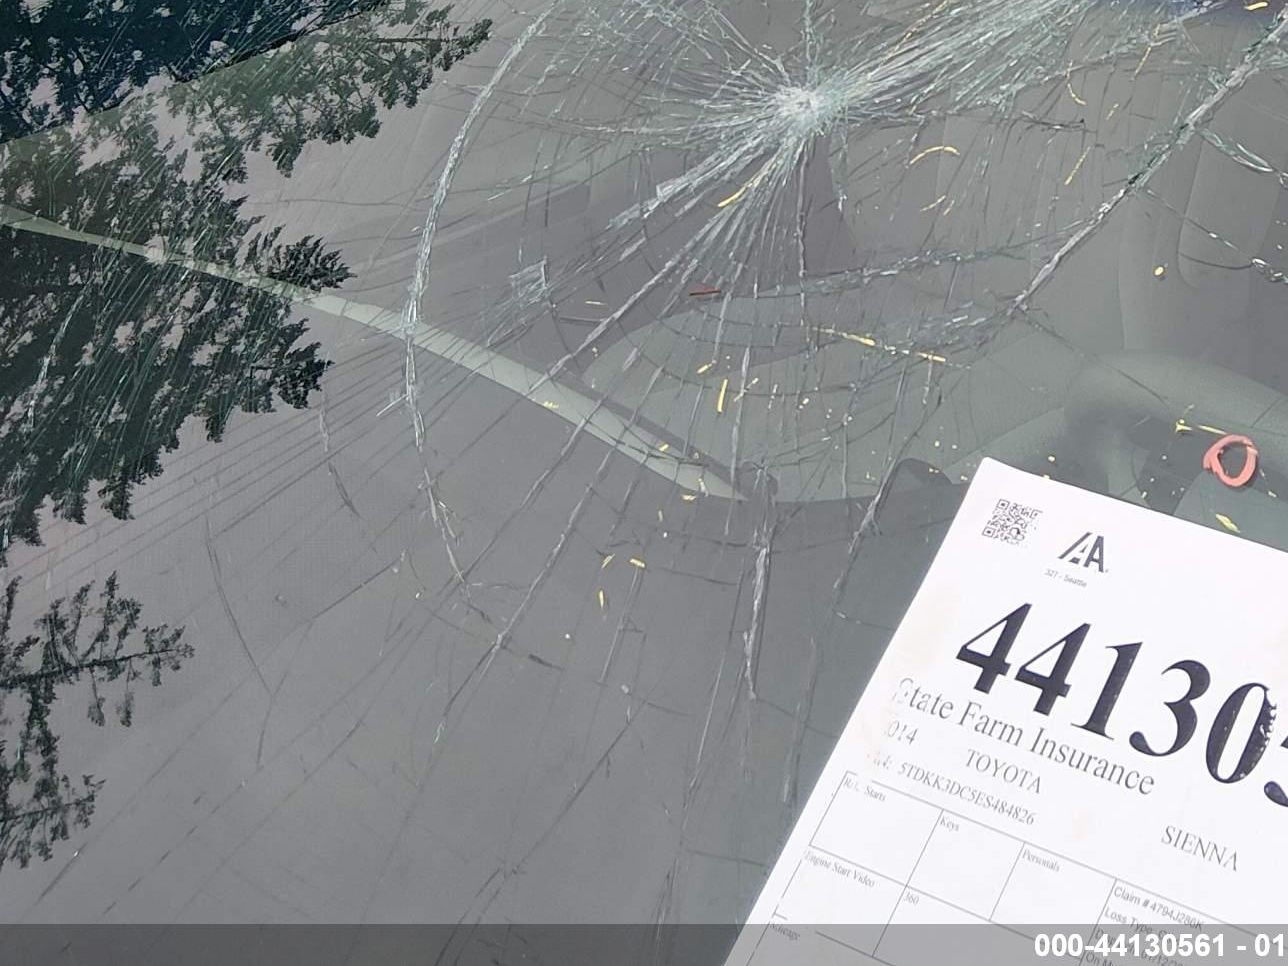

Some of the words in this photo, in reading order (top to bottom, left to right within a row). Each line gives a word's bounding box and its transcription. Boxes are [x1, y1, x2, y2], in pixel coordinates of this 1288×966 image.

[958, 700, 1023, 747] Farm
[1030, 727, 1155, 795] Insurance
[886, 720, 919, 745] 014
[966, 748, 1041, 794] TOYOTA
[1161, 825, 1238, 872] SIENNA
[898, 762, 1035, 825] 5TDKK3DC5ES484826
[940, 817, 960, 832] Keys
[1022, 849, 1060, 873] Personals
[832, 863, 850, 878] Start
[853, 869, 875, 887] Video
[904, 892, 919, 905] 360
[1113, 886, 1141, 905] Claim
[1105, 907, 1127, 924] Loss
